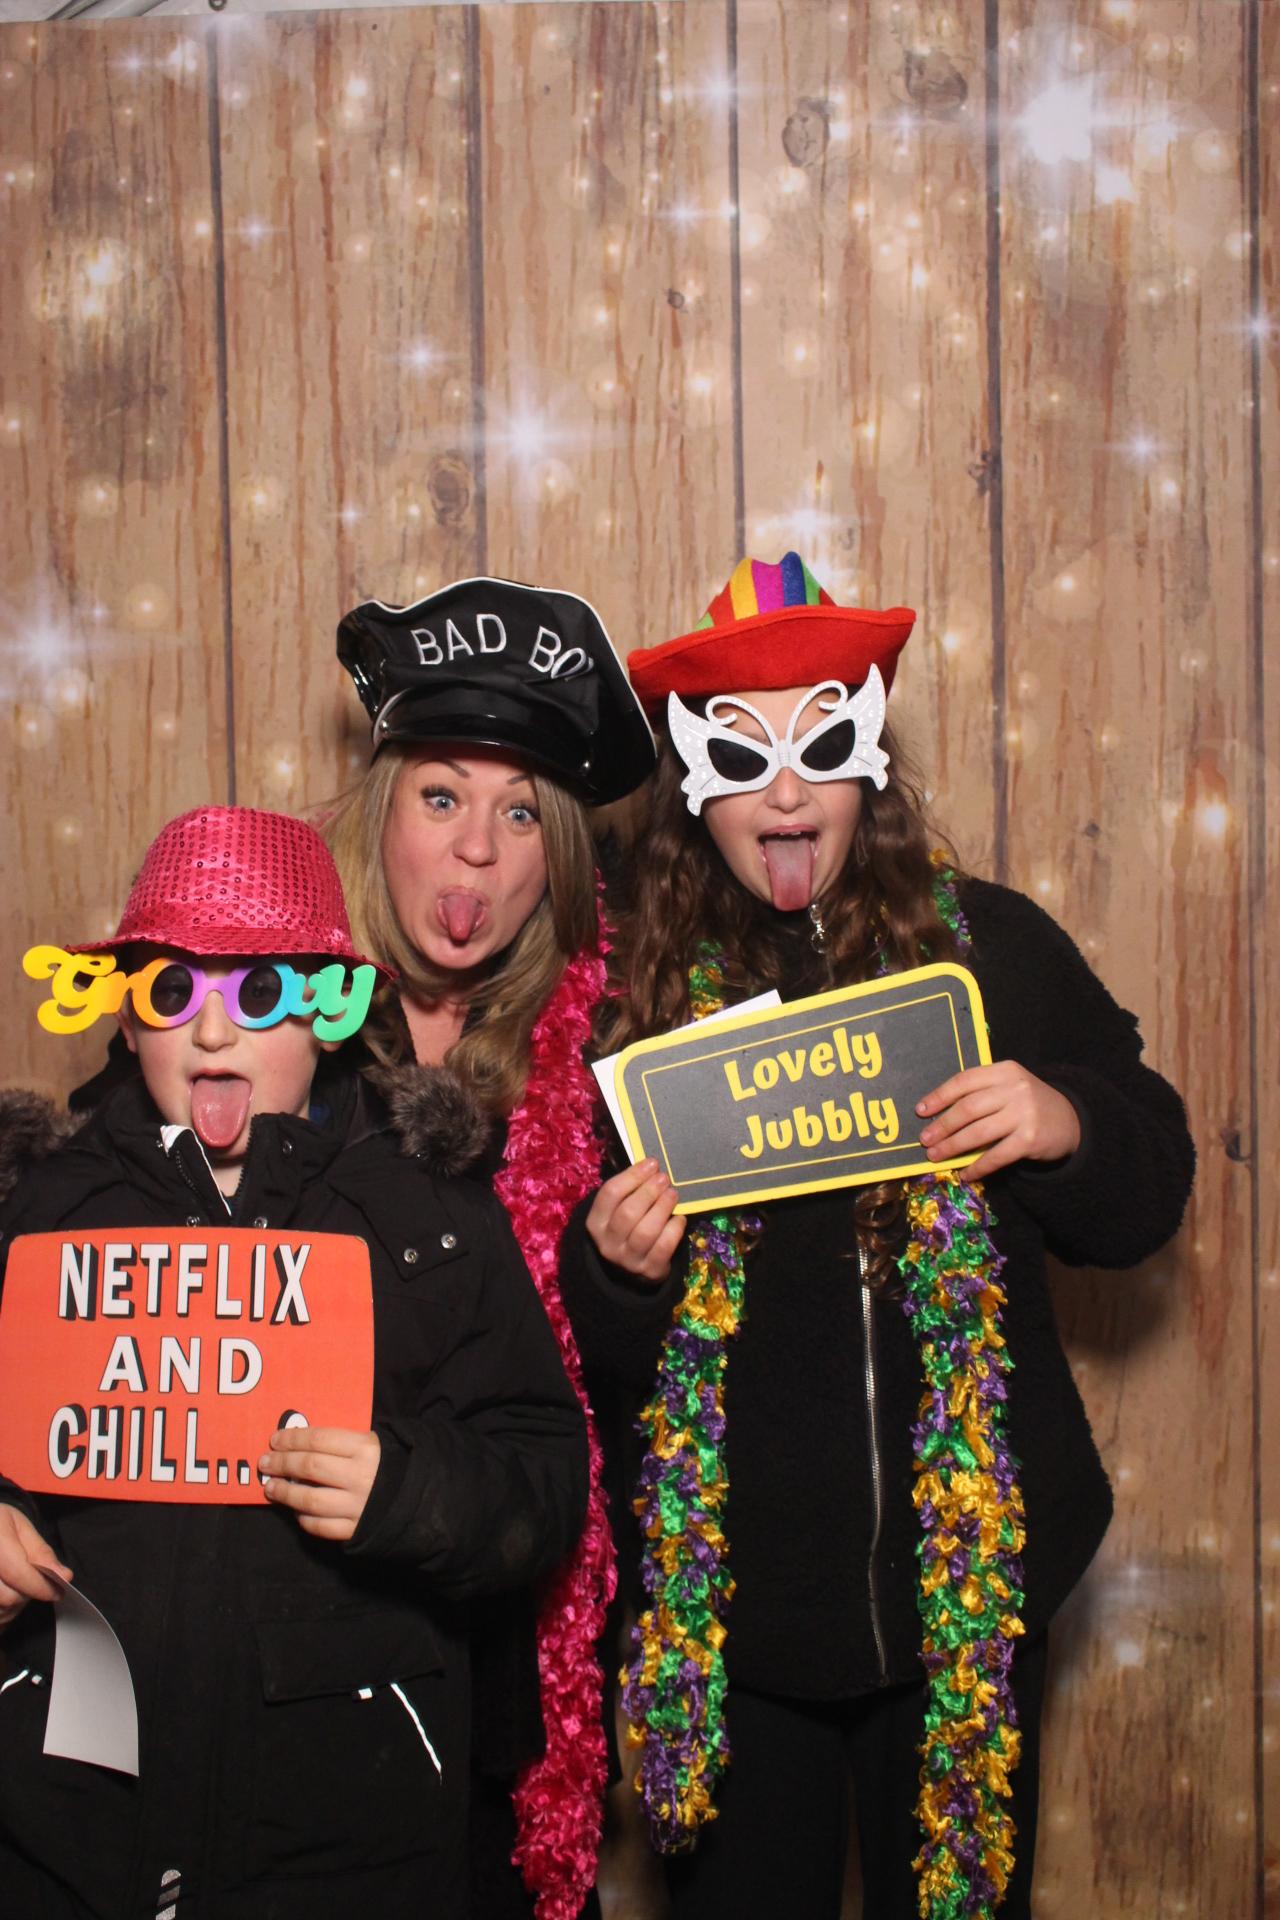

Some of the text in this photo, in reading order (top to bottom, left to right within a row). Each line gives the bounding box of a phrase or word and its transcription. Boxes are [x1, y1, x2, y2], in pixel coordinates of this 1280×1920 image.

[411, 614, 594, 682] BAD BO
[723, 1027, 883, 1102] Lovely
[740, 1092, 899, 1159] Jubbly
[58, 1242, 312, 1325] NETFLIX
[98, 1335, 263, 1395] AND
